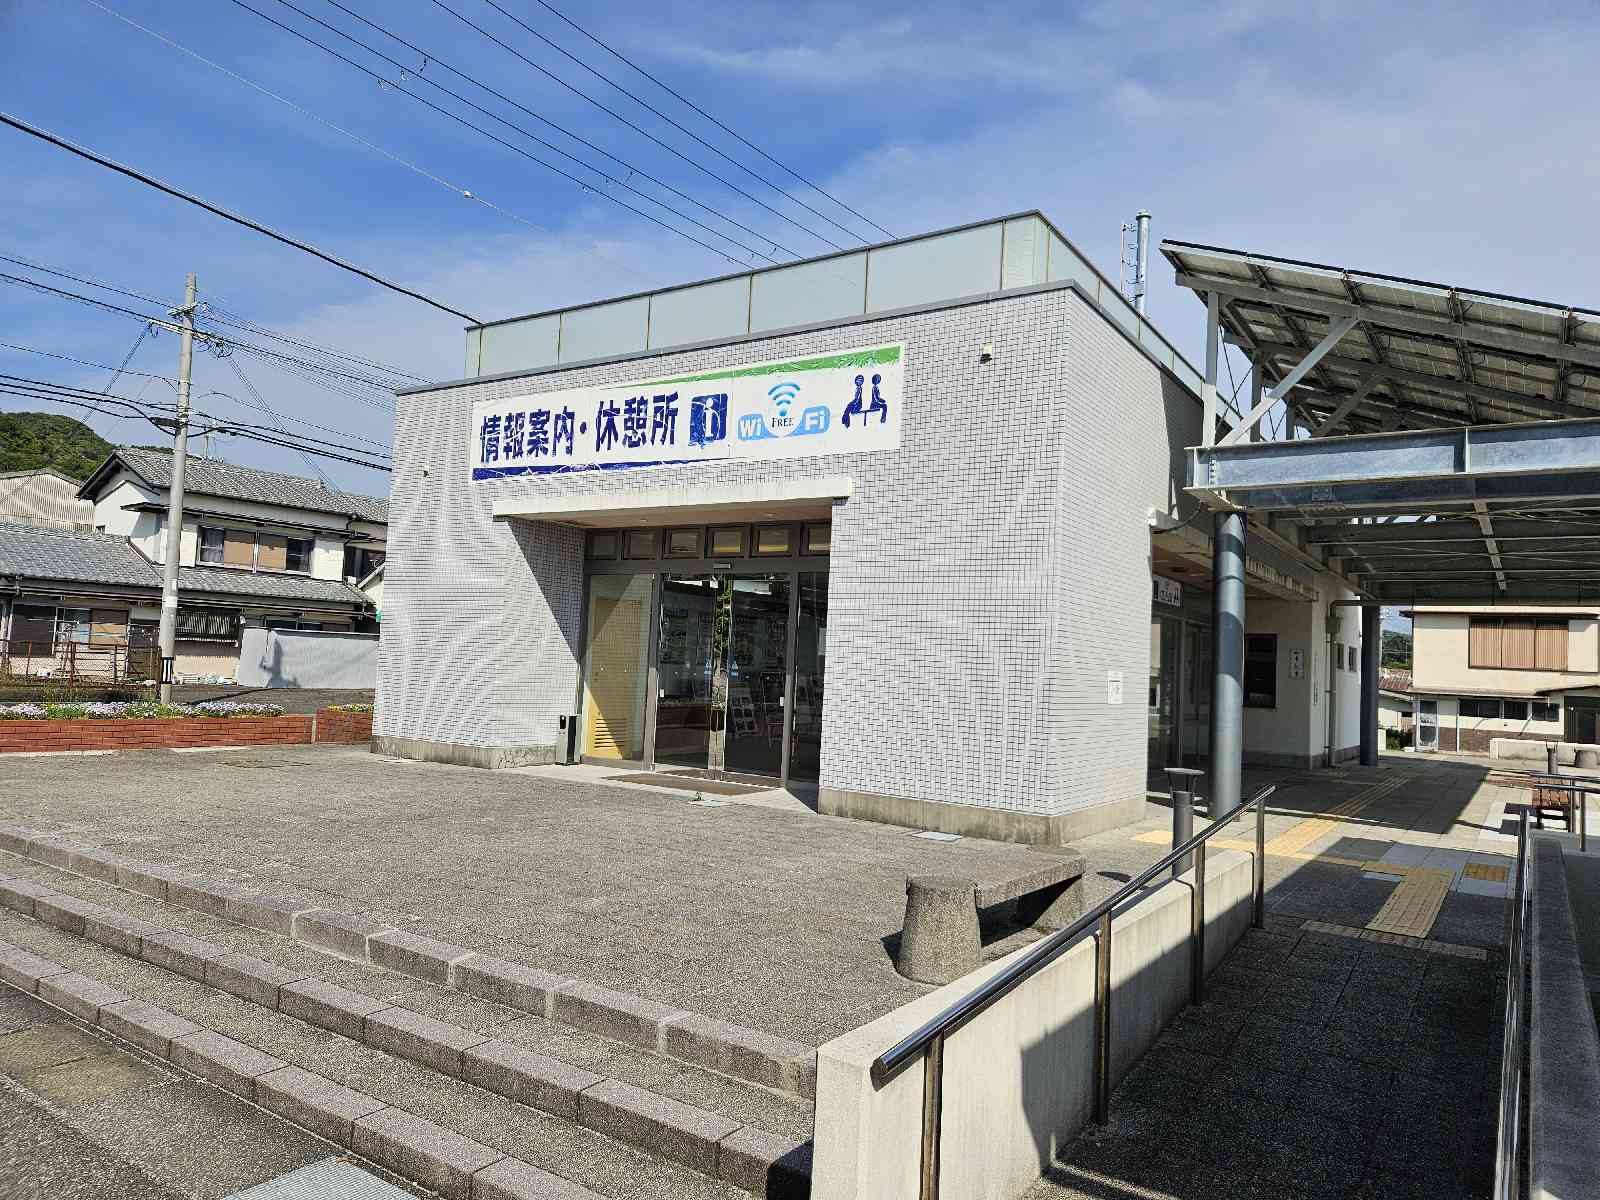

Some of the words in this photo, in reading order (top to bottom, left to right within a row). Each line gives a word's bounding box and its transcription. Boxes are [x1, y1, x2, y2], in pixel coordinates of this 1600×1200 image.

[480, 391, 679, 463] 情報案内・休憩所
[740, 418, 763, 438] Wi
[804, 409, 826, 431] Fi
